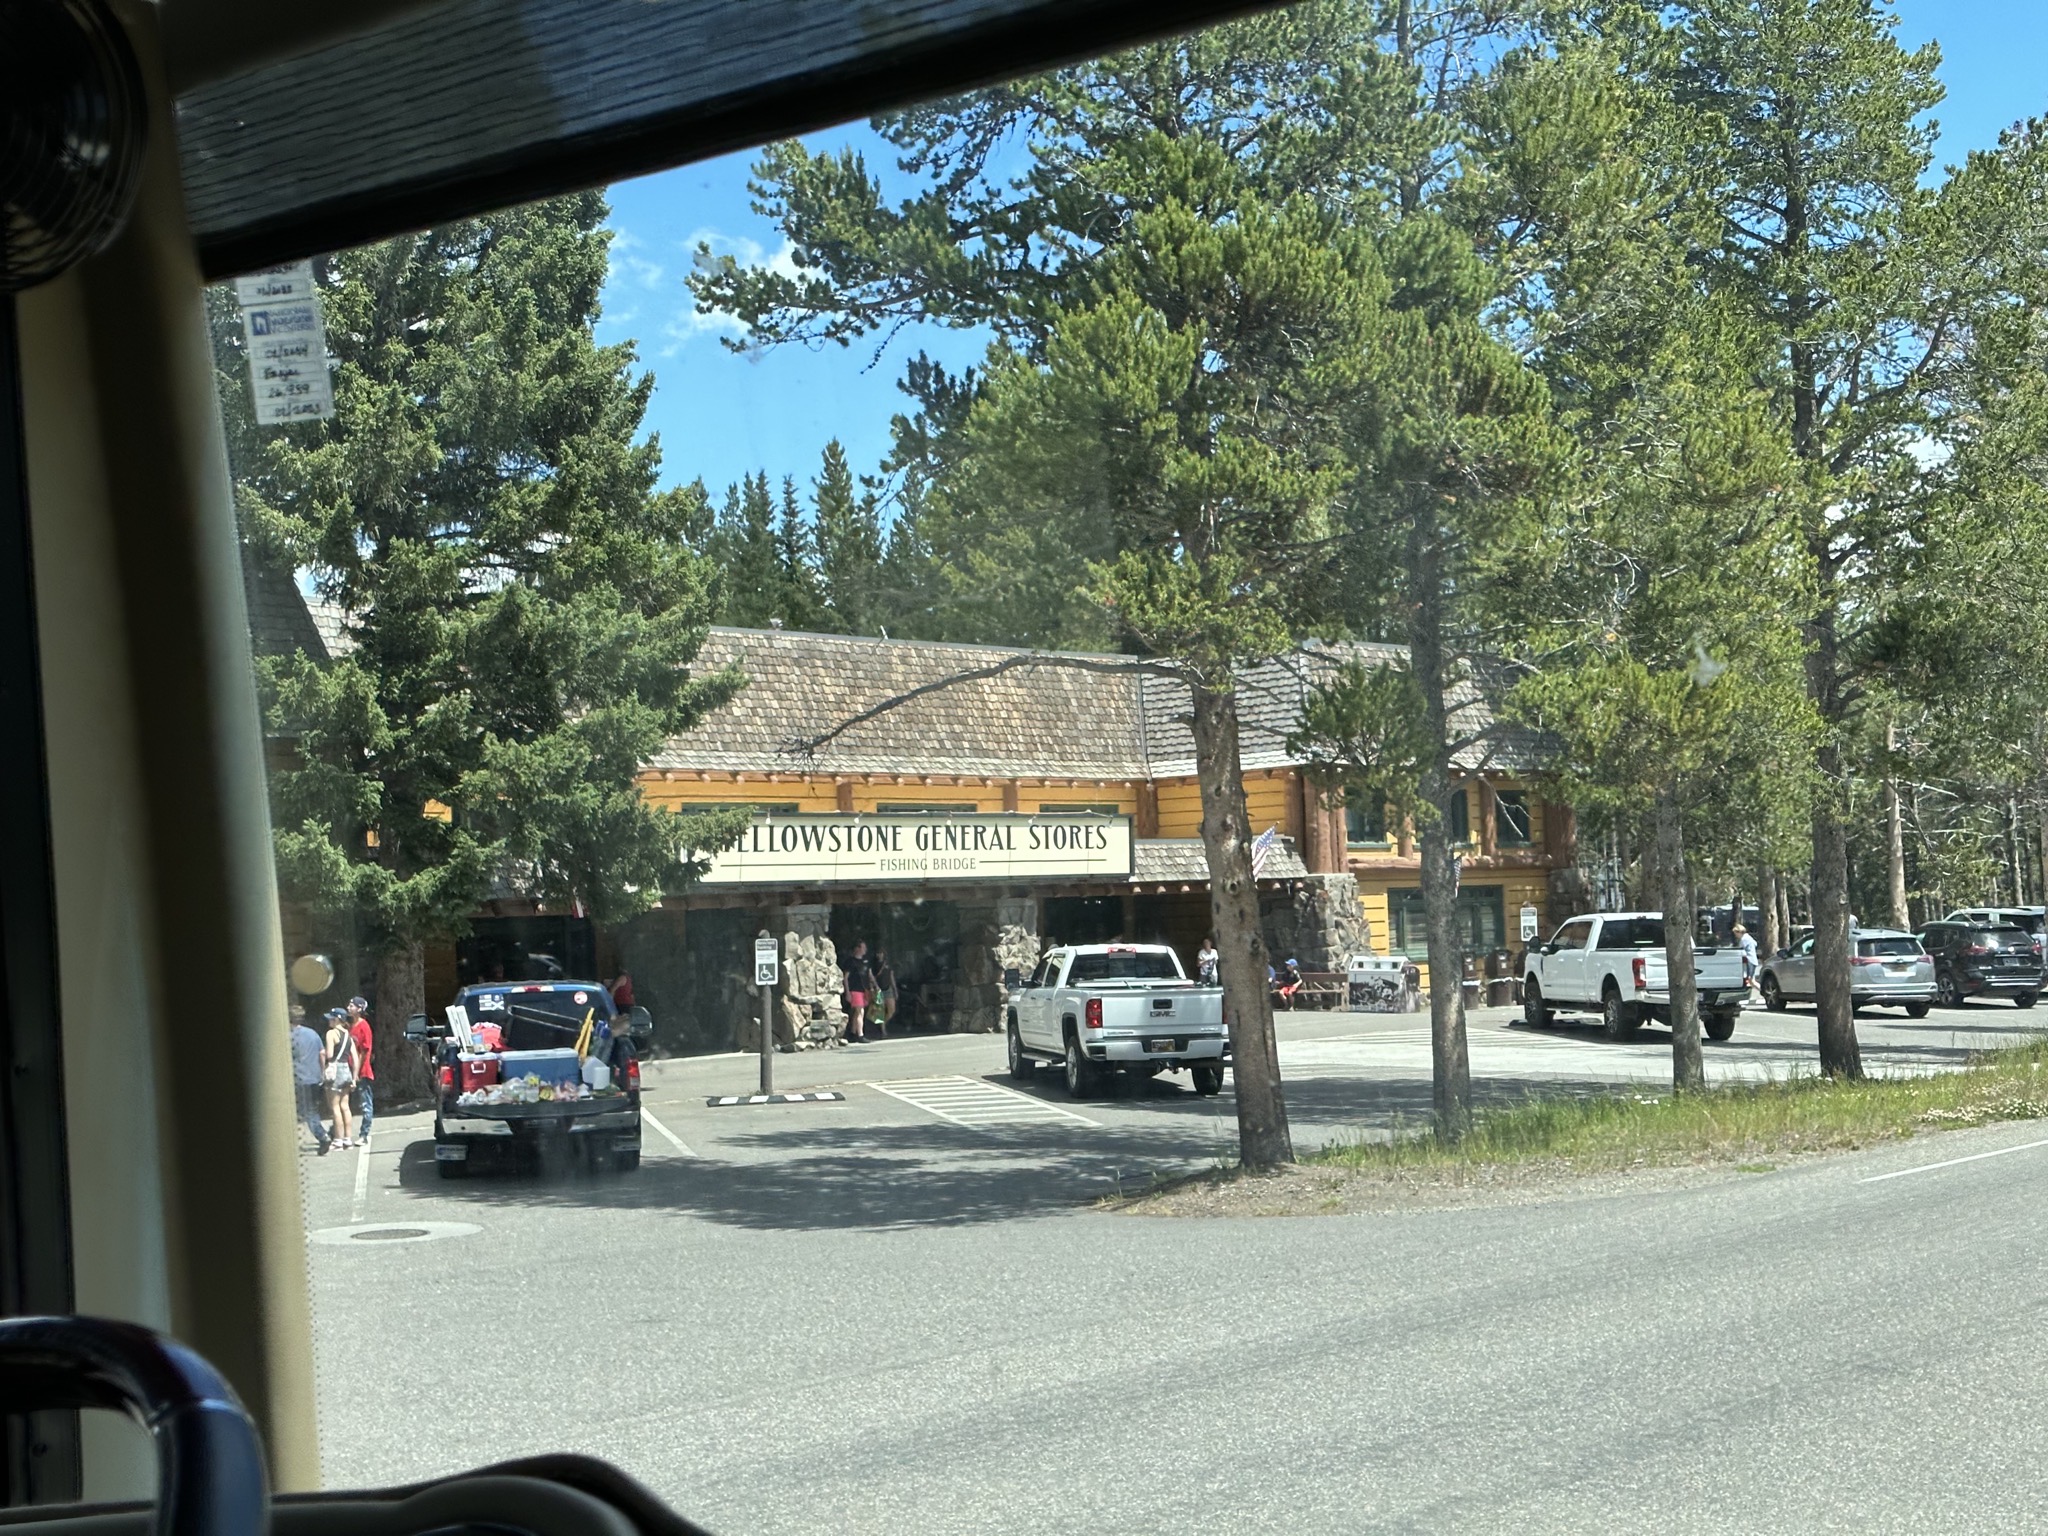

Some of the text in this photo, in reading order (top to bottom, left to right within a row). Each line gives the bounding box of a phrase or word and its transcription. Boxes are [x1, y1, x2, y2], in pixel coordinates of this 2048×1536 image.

[915, 823, 1017, 851] GENERAL
[1029, 824, 1107, 850] STORES
[880, 857, 977, 872] FISHING BRIDGE
